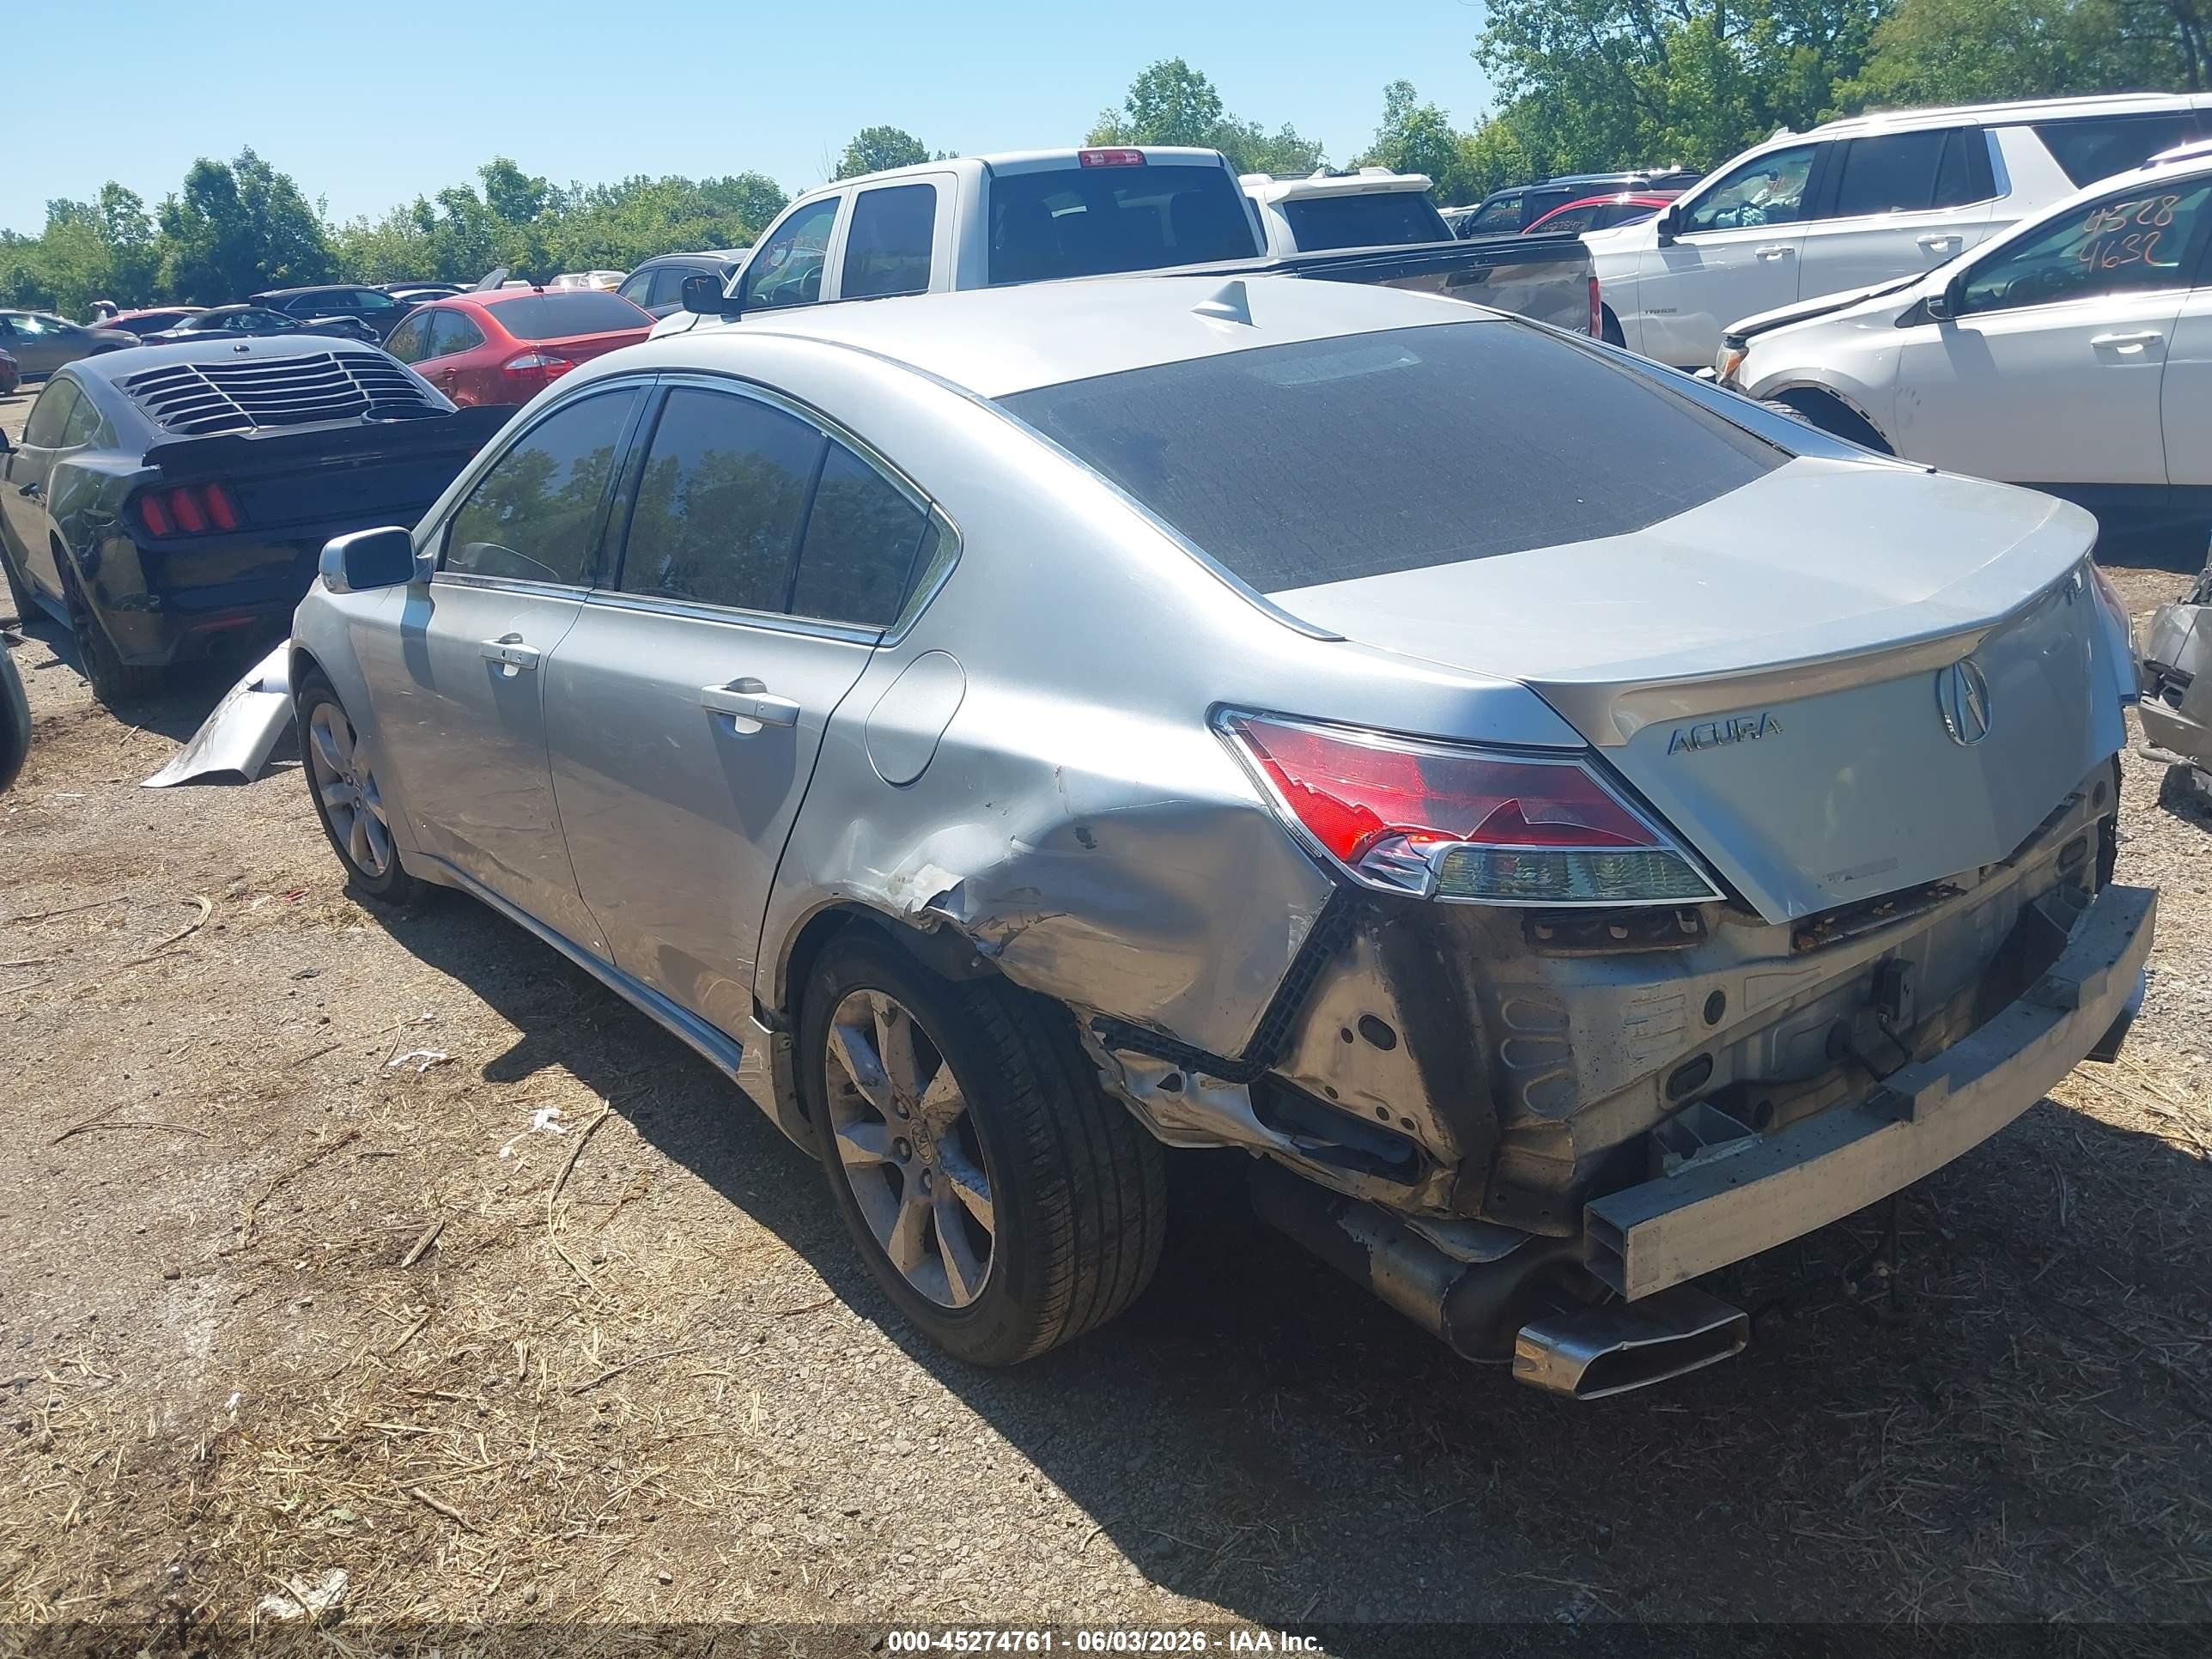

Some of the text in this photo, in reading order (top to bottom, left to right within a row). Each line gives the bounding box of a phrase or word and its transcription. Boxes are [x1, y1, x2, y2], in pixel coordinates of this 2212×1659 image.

[2083, 194, 2181, 234] 4528
[2078, 230, 2179, 273] 4632
[1667, 711, 1784, 756] ACURA
